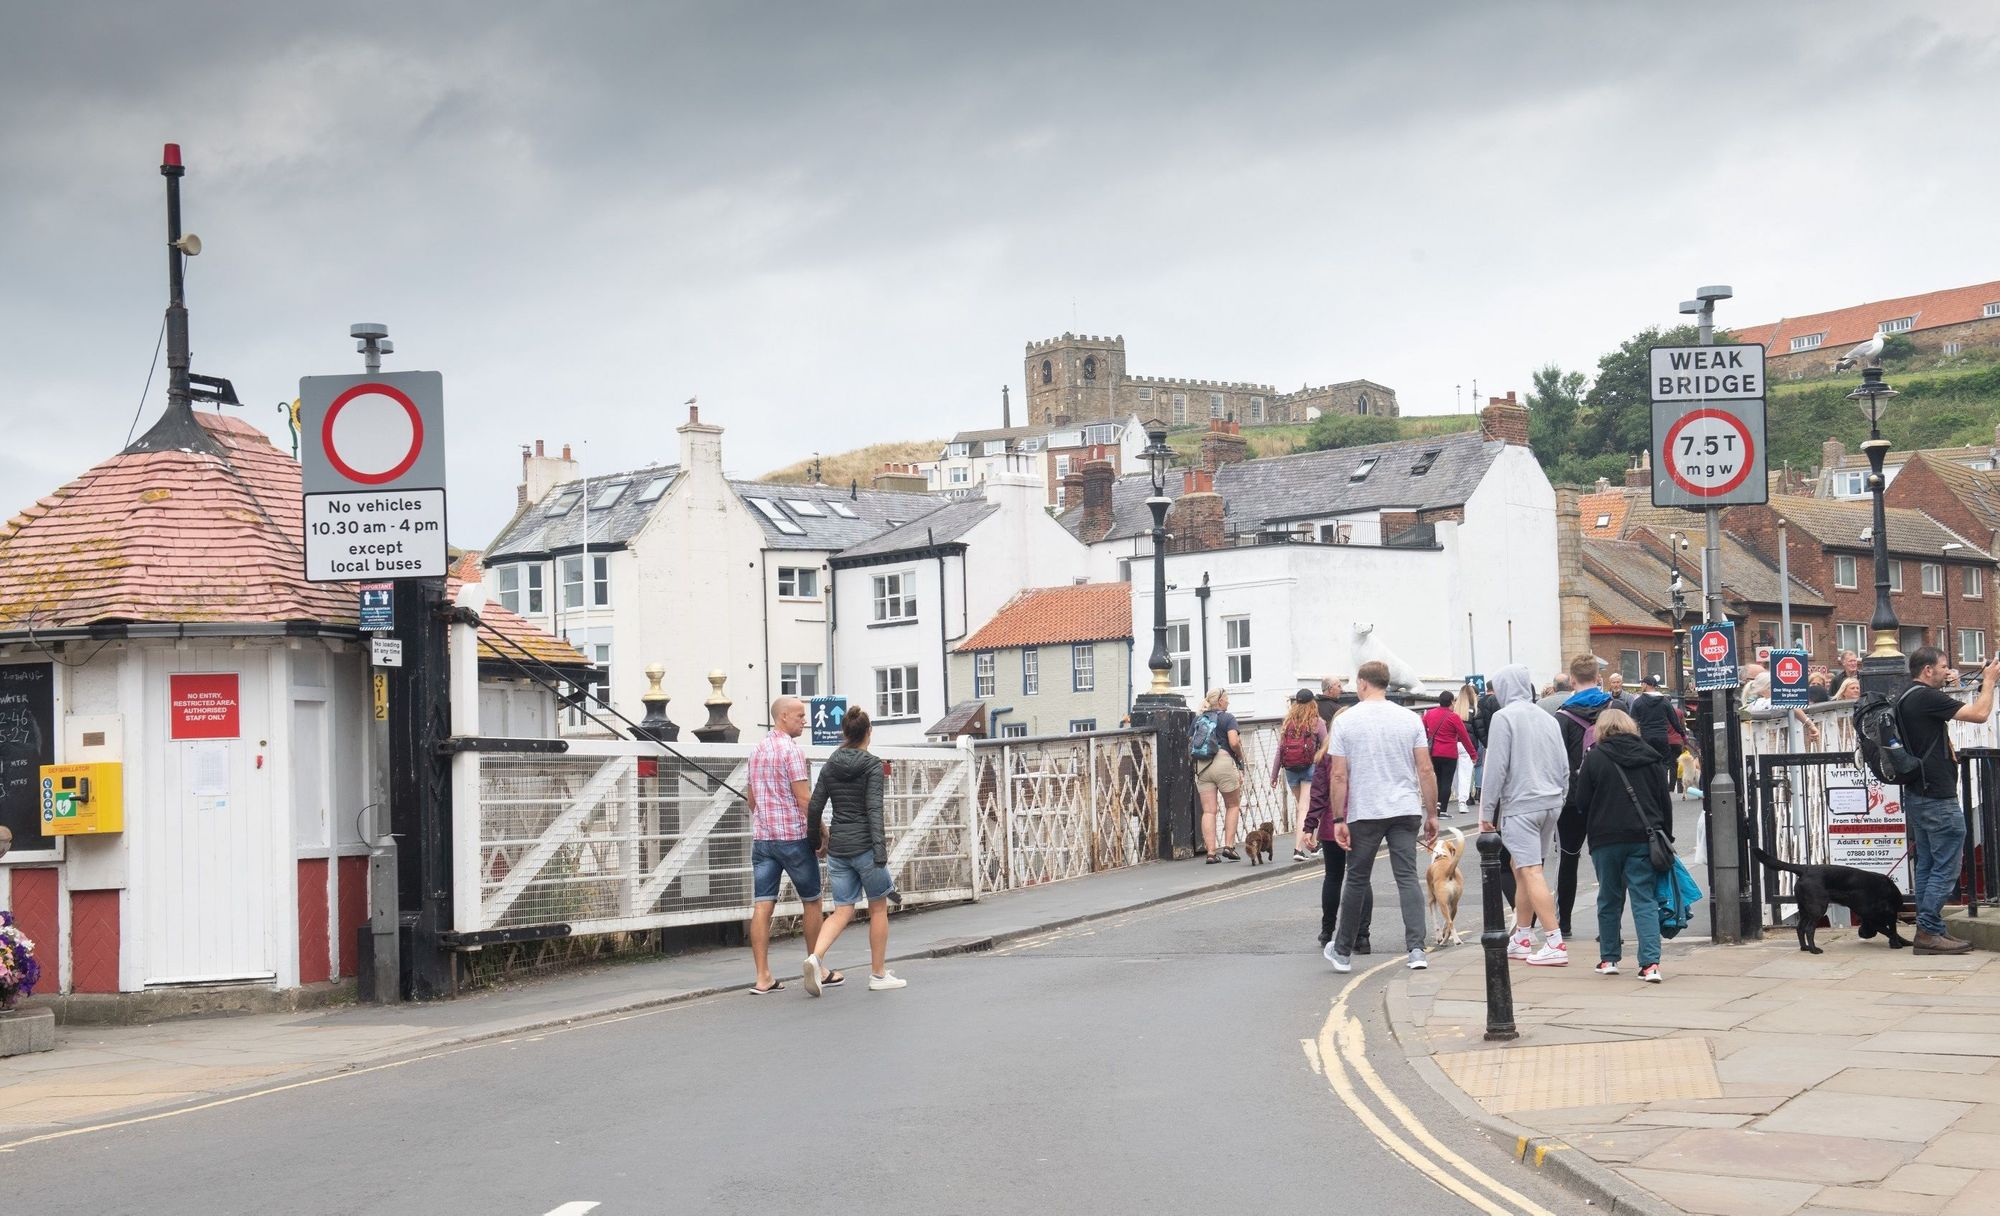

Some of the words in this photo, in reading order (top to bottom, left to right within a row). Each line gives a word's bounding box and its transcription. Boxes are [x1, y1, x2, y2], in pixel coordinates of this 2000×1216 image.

[1670, 350, 1743, 370] WEAK
[1659, 374, 1756, 394] BRIDGE
[328, 500, 350, 514] No
[357, 498, 422, 512] vehicles
[312, 521, 359, 535] 10.30
[363, 523, 386, 533] am
[400, 519, 410, 532] 4
[414, 520, 438, 533] pm
[349, 541, 403, 556] except
[331, 559, 369, 572] local
[376, 559, 422, 571] buses
[1704, 645, 1725, 655] ACCESS
[1831, 770, 1865, 778] WHITBY
